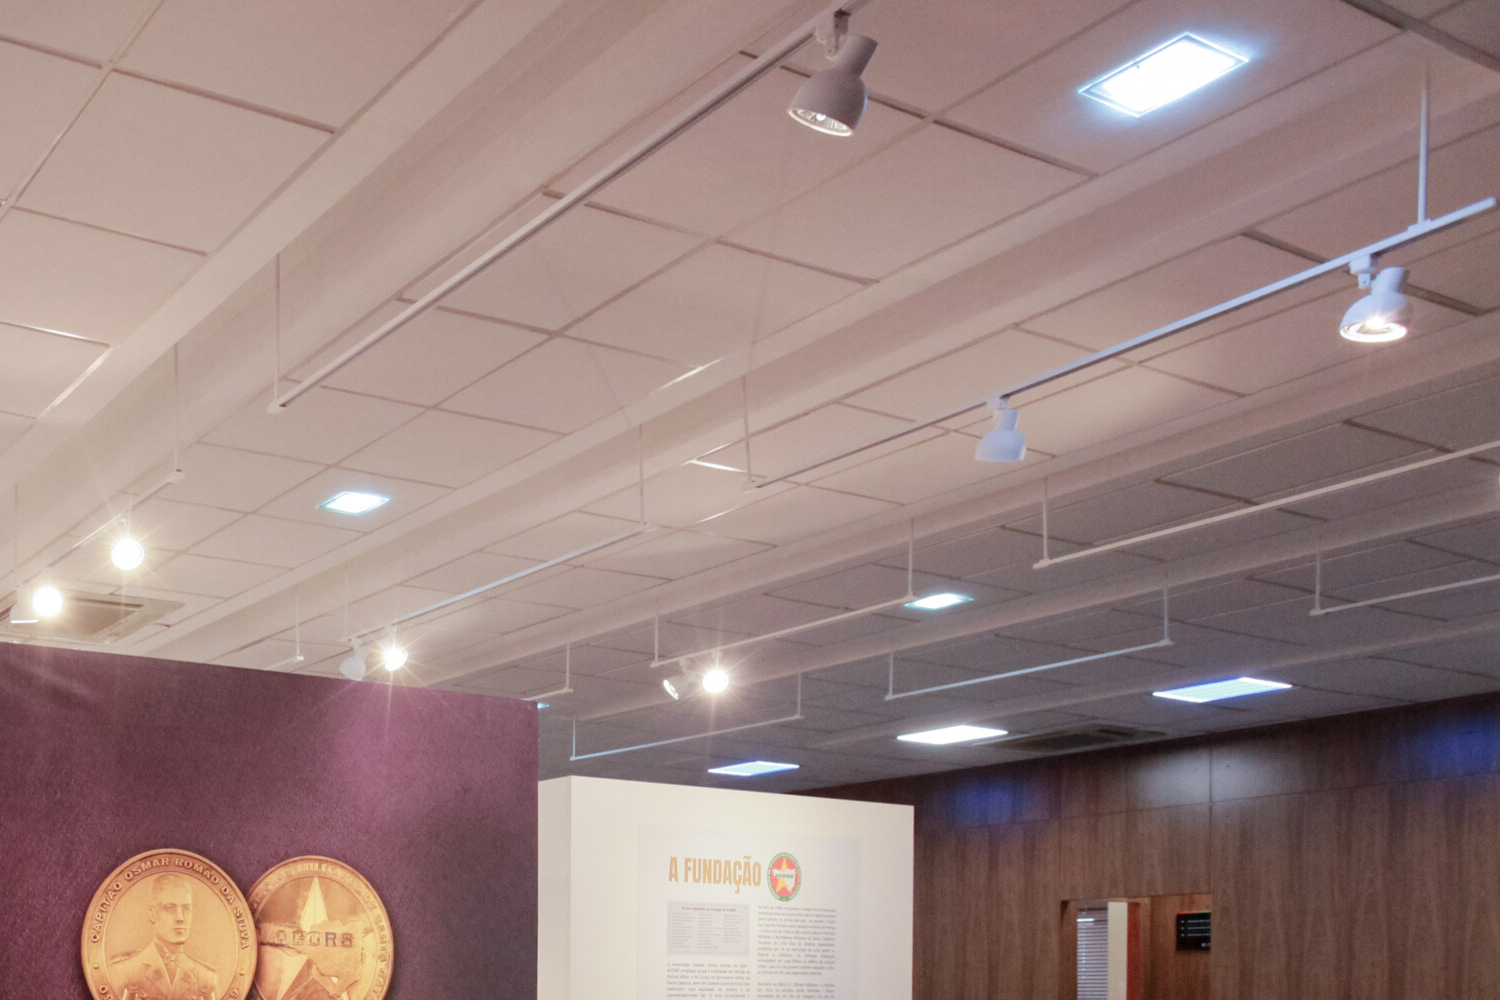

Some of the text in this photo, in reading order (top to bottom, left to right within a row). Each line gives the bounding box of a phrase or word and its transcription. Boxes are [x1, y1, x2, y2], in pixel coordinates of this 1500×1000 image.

[124, 857, 170, 881] OSMAR
[668, 856, 679, 882] A
[684, 855, 762, 894] FUNDAÇÃO
[274, 930, 354, 948] ACORS
